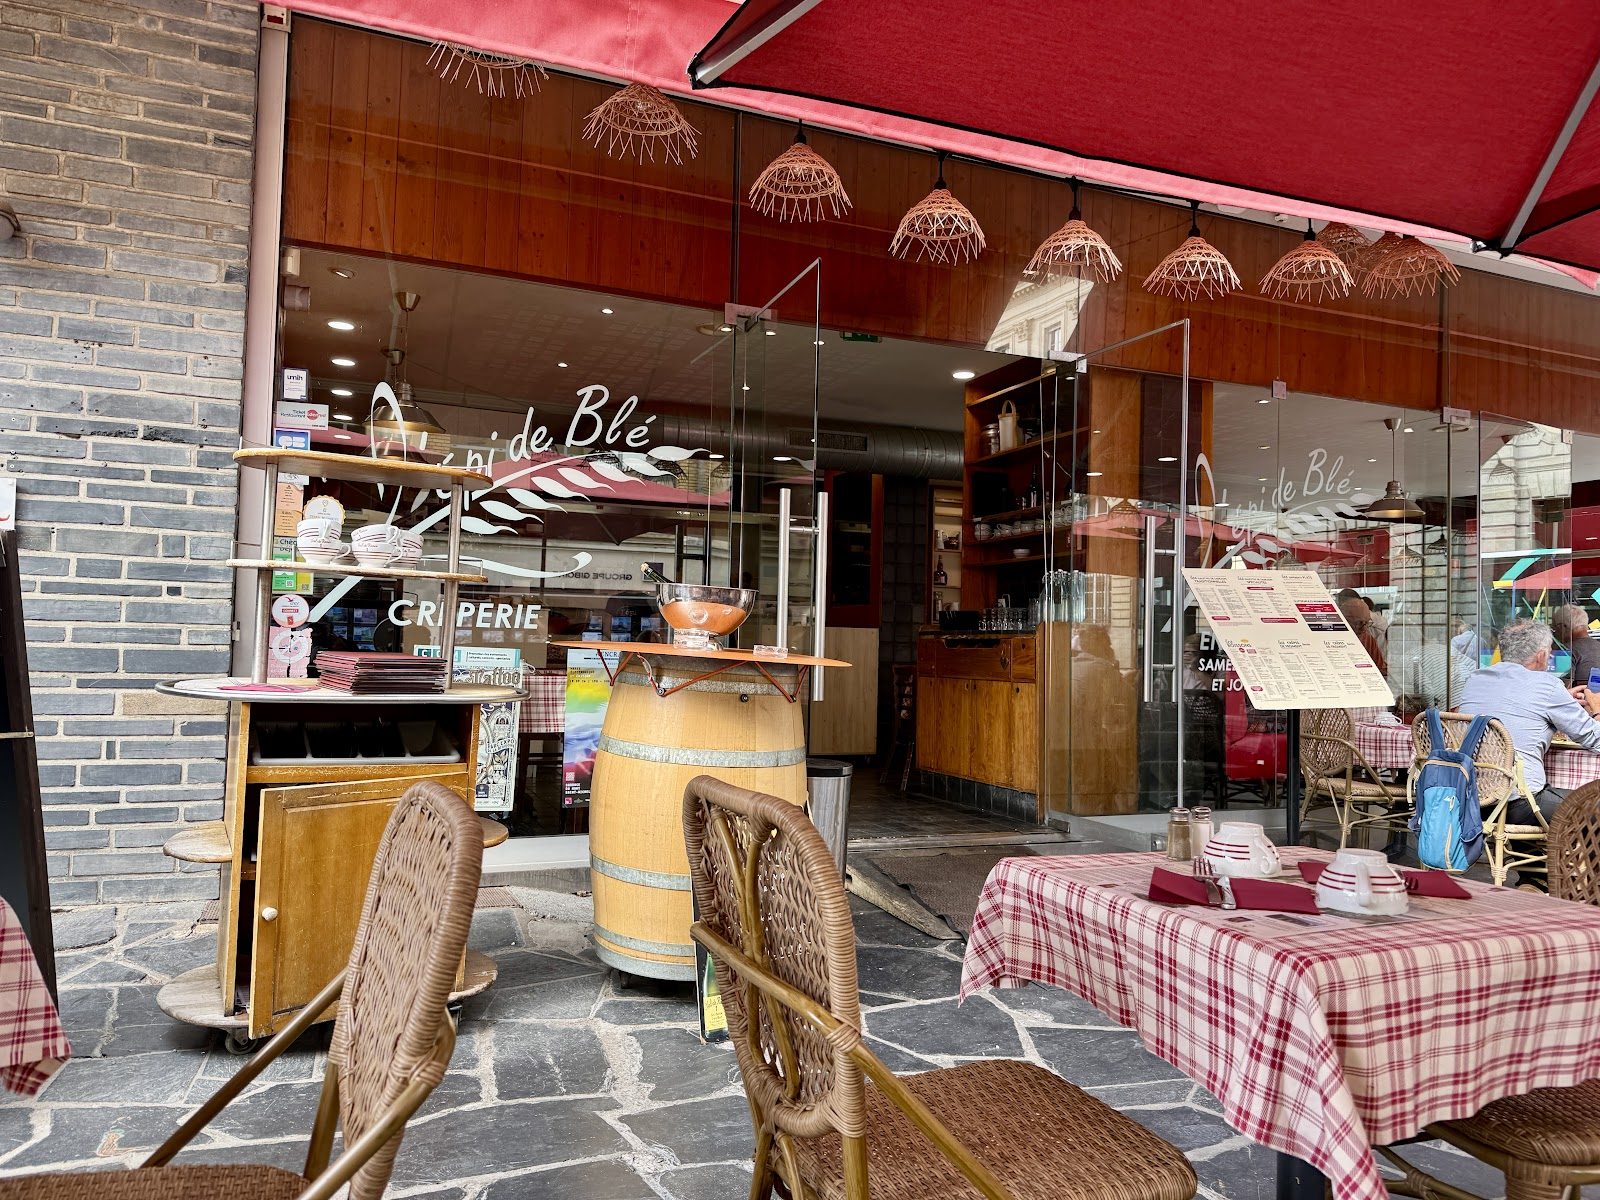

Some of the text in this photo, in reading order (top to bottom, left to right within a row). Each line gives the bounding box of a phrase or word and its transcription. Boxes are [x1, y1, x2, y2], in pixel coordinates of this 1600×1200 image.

[510, 406, 553, 462] de
[565, 384, 657, 448] Blé
[1272, 466, 1296, 509] de
[1302, 448, 1355, 497] Blé
[388, 600, 541, 630] CRPERIE
[470, 667, 521, 686] Tattoo
[1198, 657, 1237, 672] SAME
[1212, 678, 1225, 692] ET
